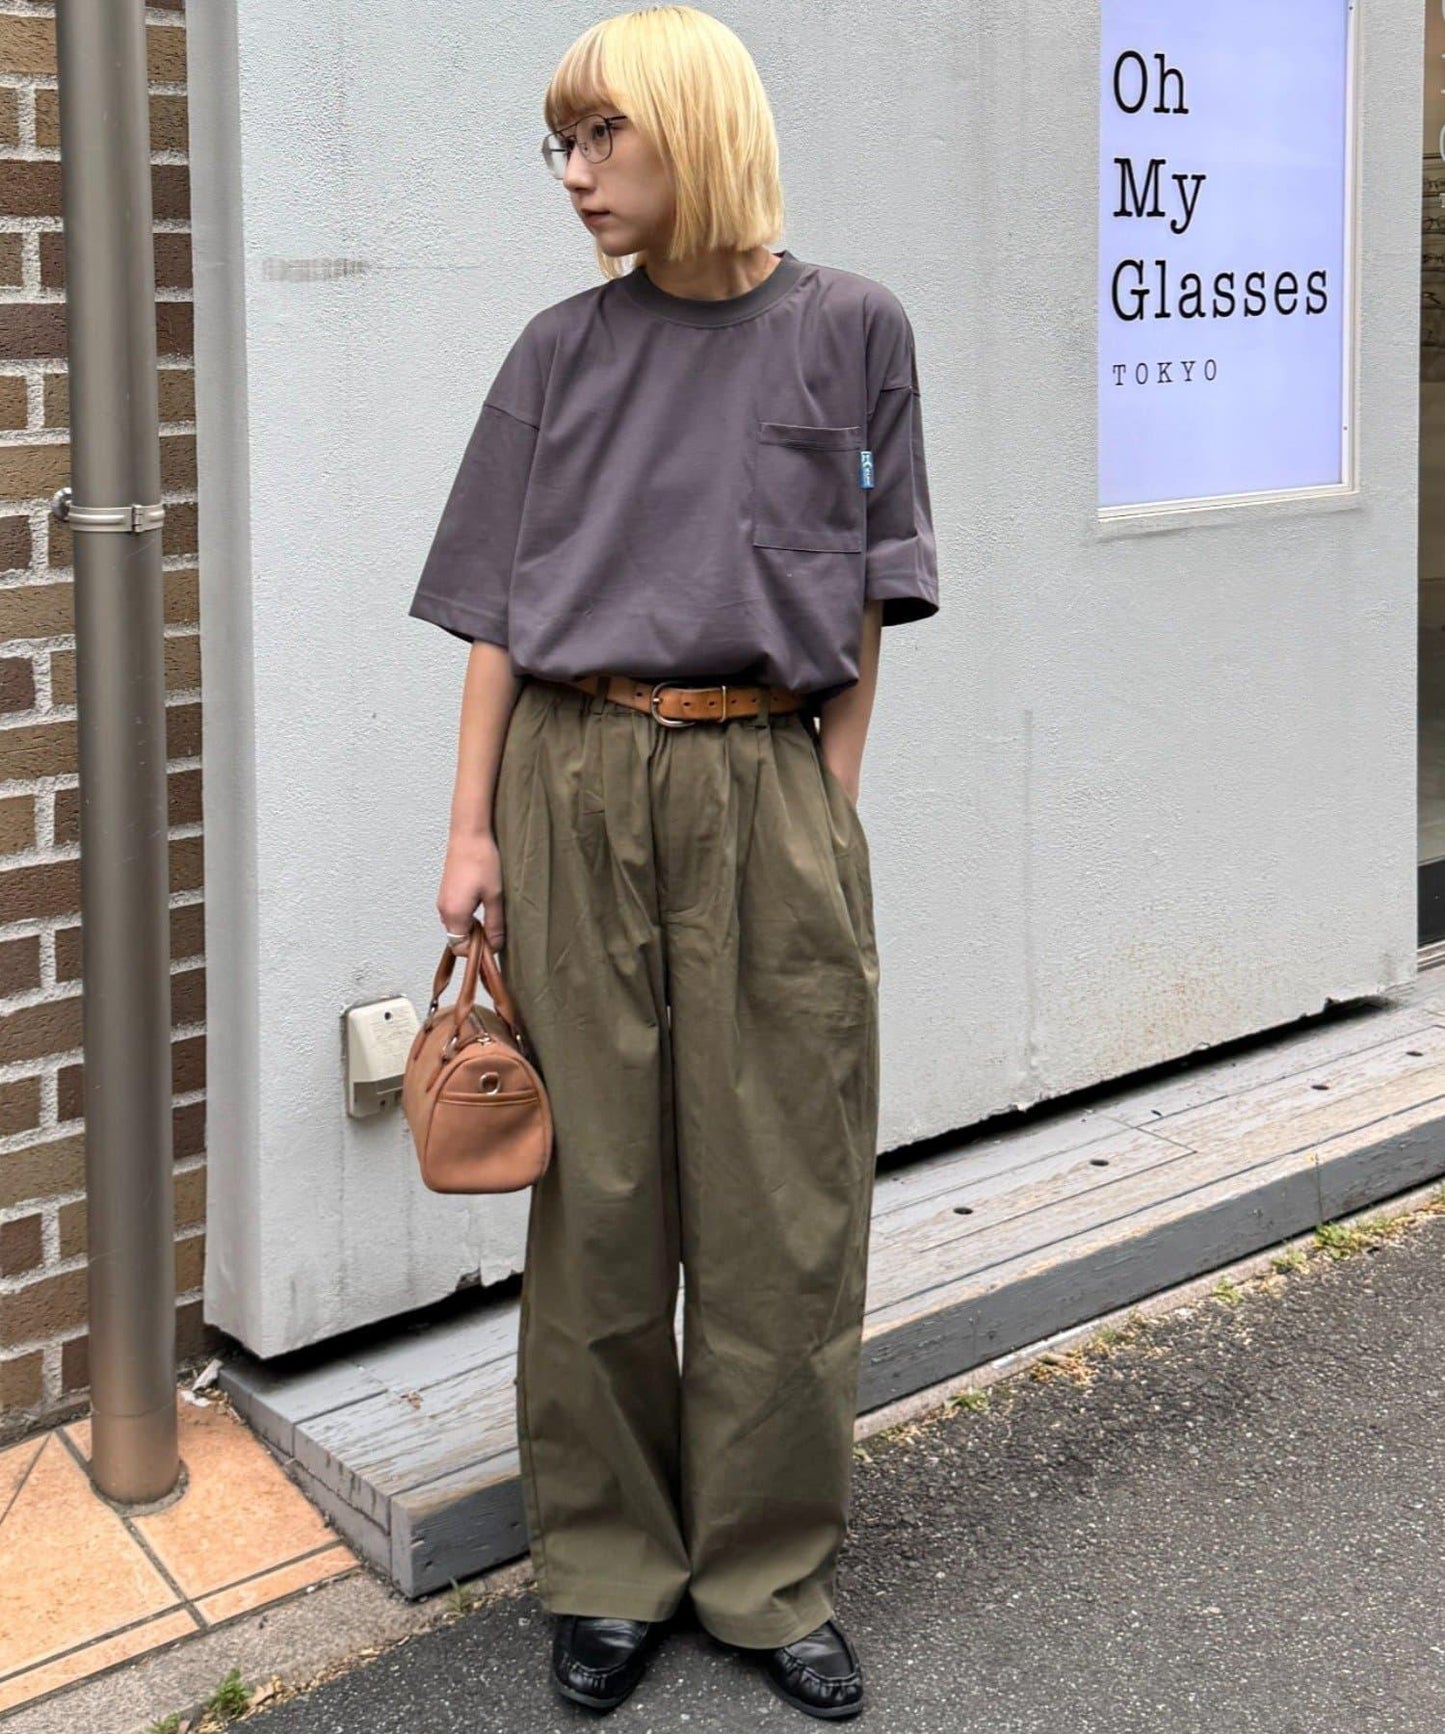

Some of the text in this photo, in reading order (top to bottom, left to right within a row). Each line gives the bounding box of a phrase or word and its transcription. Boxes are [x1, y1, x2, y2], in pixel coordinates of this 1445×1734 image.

[1113, 50, 1190, 115] Oh
[1112, 157, 1207, 235] My
[1111, 259, 1328, 322] Glasses
[1112, 358, 1218, 386] TOKYO
